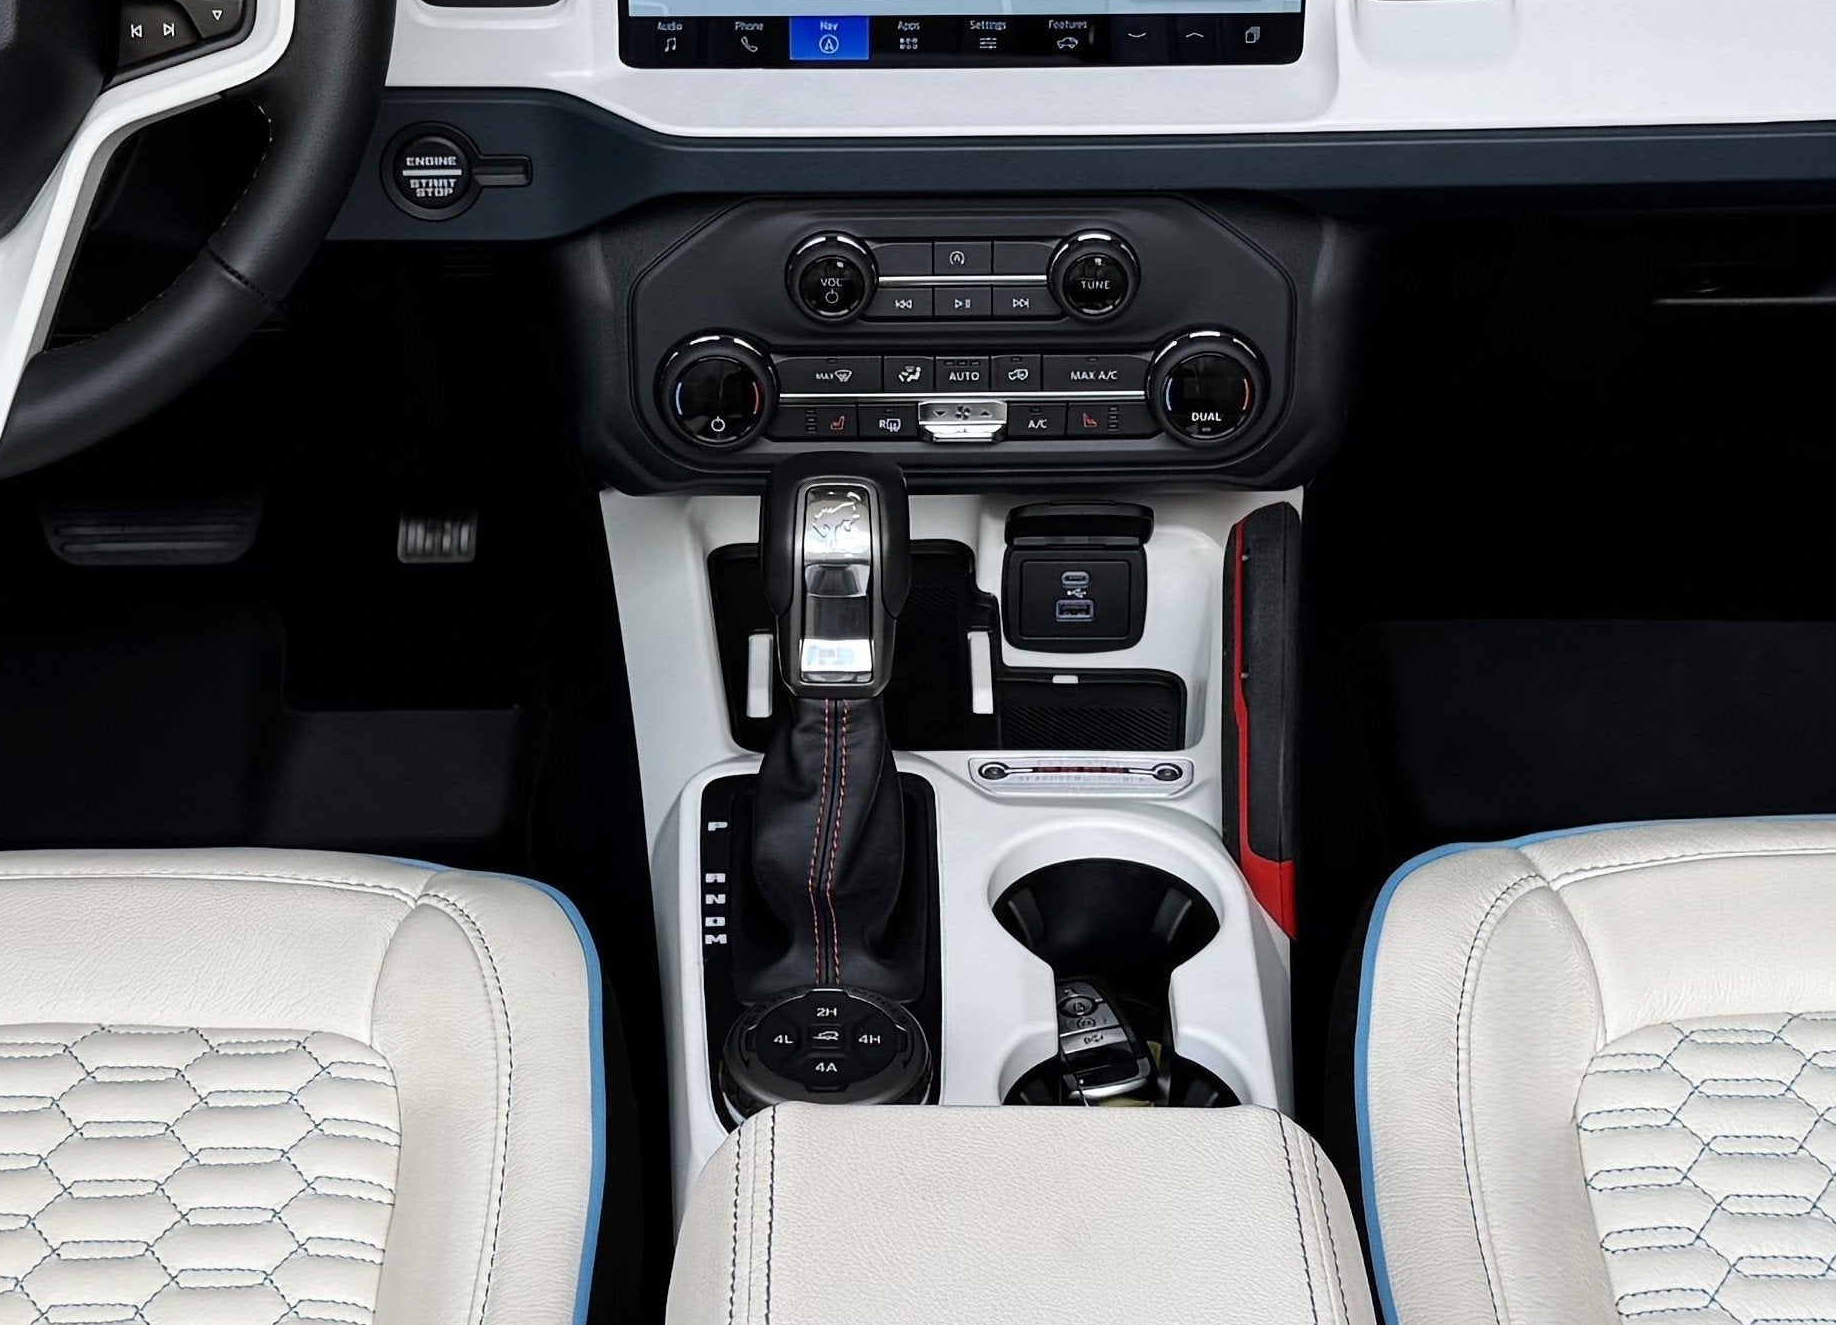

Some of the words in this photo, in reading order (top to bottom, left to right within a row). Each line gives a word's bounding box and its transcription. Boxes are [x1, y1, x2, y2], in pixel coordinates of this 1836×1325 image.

[734, 21, 764, 31] Phone
[820, 21, 839, 31] Nav
[897, 21, 920, 32] Apps
[970, 20, 1007, 31] Settings
[406, 156, 457, 166] ENGINE
[409, 179, 457, 188] START
[416, 188, 454, 197] STOP
[820, 278, 843, 287] VOL
[1081, 280, 1111, 290] TUNE
[949, 372, 980, 381] AUTO
[1070, 371, 1096, 380] MAX
[1098, 371, 1118, 380] A/C
[1191, 412, 1222, 422] DUAL
[1028, 420, 1047, 429] A/C
[705, 894, 726, 904] N
[705, 934, 727, 944] M
[816, 1008, 837, 1017] 2H
[773, 1035, 793, 1044] 4L
[858, 1034, 881, 1044] 4H
[815, 1062, 837, 1072] 4A
